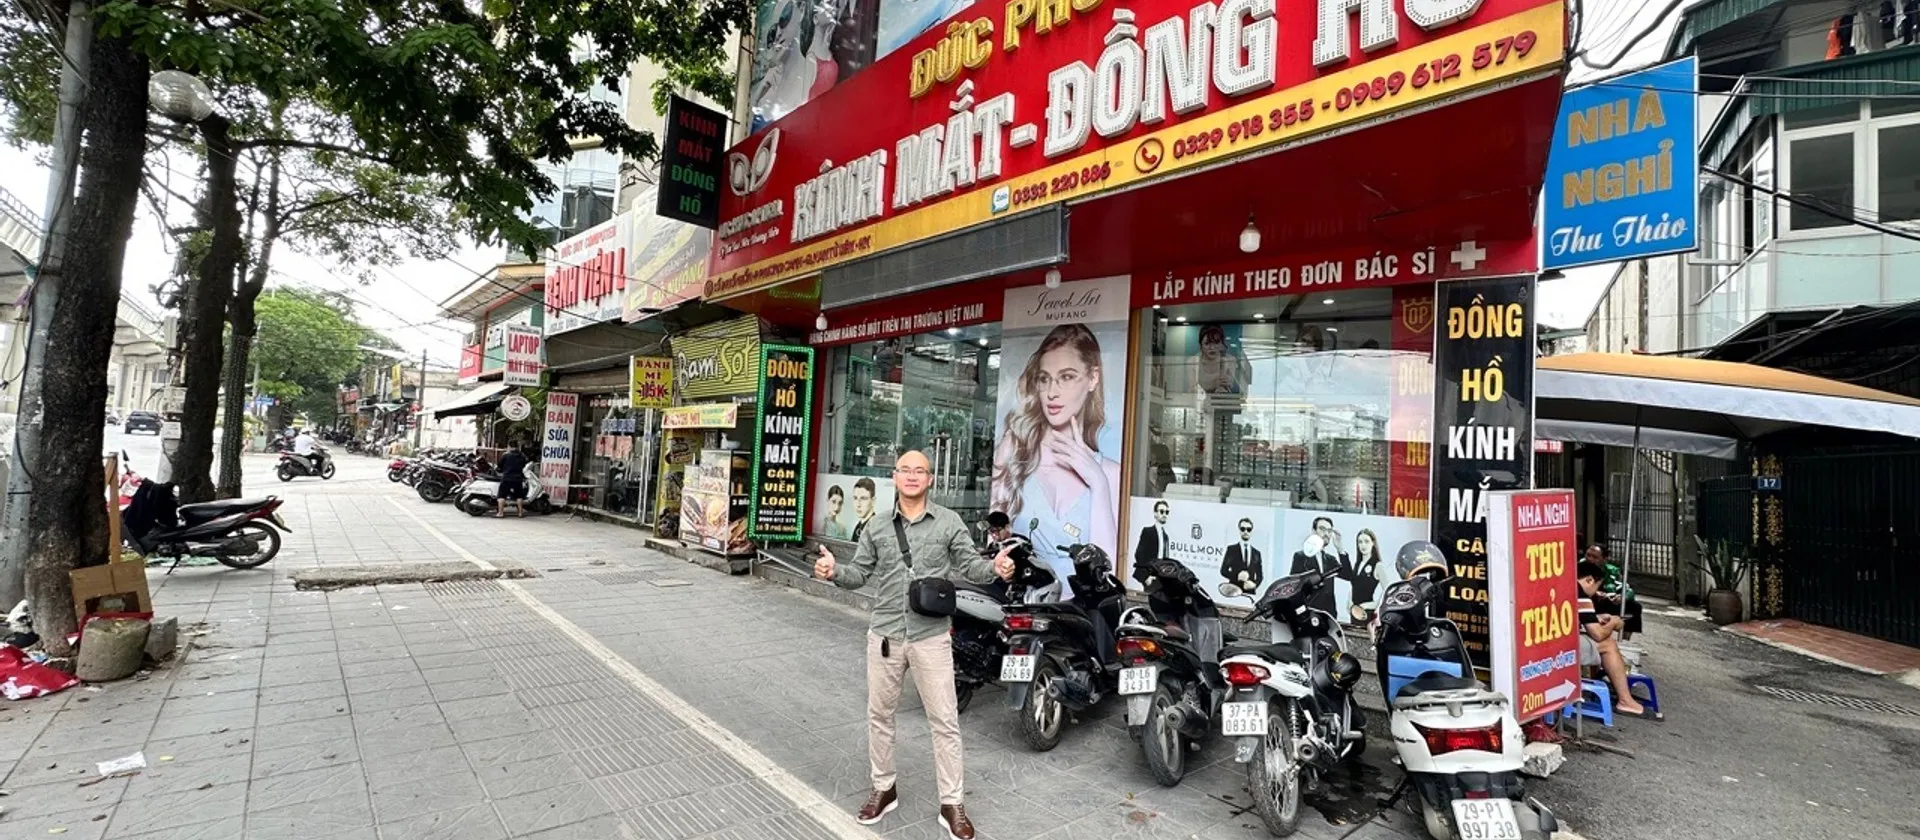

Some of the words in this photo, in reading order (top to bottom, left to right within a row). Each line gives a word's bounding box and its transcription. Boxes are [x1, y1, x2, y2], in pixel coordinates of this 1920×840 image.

[909, 16, 994, 98] ĐỨC
[1003, 0, 1098, 52] PH
[1173, 126, 1223, 159] 0329
[1227, 113, 1264, 145] 918
[1269, 96, 1315, 131] 355
[1334, 69, 1406, 112] 0989
[1410, 52, 1462, 89] 612
[1472, 29, 1538, 70] 579
[678, 110, 717, 138] KÍNH
[790, 148, 884, 243] KÍNH
[892, 79, 1015, 209] MẮT
[1043, 0, 1278, 159] ĐỒNG
[1312, 0, 1484, 68] H
[1567, 84, 1667, 148] NHÀ
[671, 163, 716, 192] ĐỒNG
[1563, 138, 1675, 209] NGHỈ
[1012, 181, 1048, 206] 0332
[1050, 172, 1079, 195] 220
[679, 193, 702, 216] HỒ
[1550, 223, 1604, 257] Thu
[1612, 211, 1689, 248] Thảo
[546, 266, 580, 319] BỆNH
[582, 248, 615, 307] VIỆN
[1153, 270, 1185, 301] LẮP
[1192, 270, 1235, 297] KÍNH
[1244, 265, 1291, 292] THEO
[1301, 260, 1343, 286] ĐƠN
[1355, 250, 1399, 281] BÁC
[1412, 245, 1436, 275] SĨ
[943, 306, 962, 328] VIỆT
[962, 302, 984, 321] NAM
[1027, 289, 1073, 318] Jewel
[1068, 286, 1103, 309] Art
[1045, 309, 1088, 322] MUFANG
[1447, 293, 1523, 340] ĐỒNG
[508, 333, 540, 355] LAPTOP
[767, 353, 809, 380] ĐỒNG
[1461, 355, 1504, 402] HỒ
[548, 393, 576, 408] MUA
[775, 382, 797, 408] HỒ
[547, 407, 574, 424] BÁN
[765, 411, 804, 436] KÍNH
[764, 438, 800, 465] MẮT
[1448, 416, 1516, 461] KÍNH
[541, 463, 569, 480] LAPTOP
[766, 467, 795, 480] CẬN
[1763, 478, 1777, 488] 17
[1393, 491, 1430, 519] CHÍN
[1448, 475, 1492, 523] MẮ
[1518, 498, 1543, 529] NHÀ
[1543, 495, 1570, 526] NGHỈ
[1456, 537, 1489, 556] CẬ
[1453, 561, 1487, 579] VIỄ
[1525, 540, 1567, 582] THU
[1449, 586, 1489, 606] LOẠ
[1520, 588, 1574, 648] THẢO
[1229, 703, 1261, 718] 37-PA
[1522, 691, 1544, 714] 20m
[1225, 719, 1264, 733] 083.61
[1460, 802, 1504, 820] 29-P1
[1462, 821, 1517, 840] 997.38
